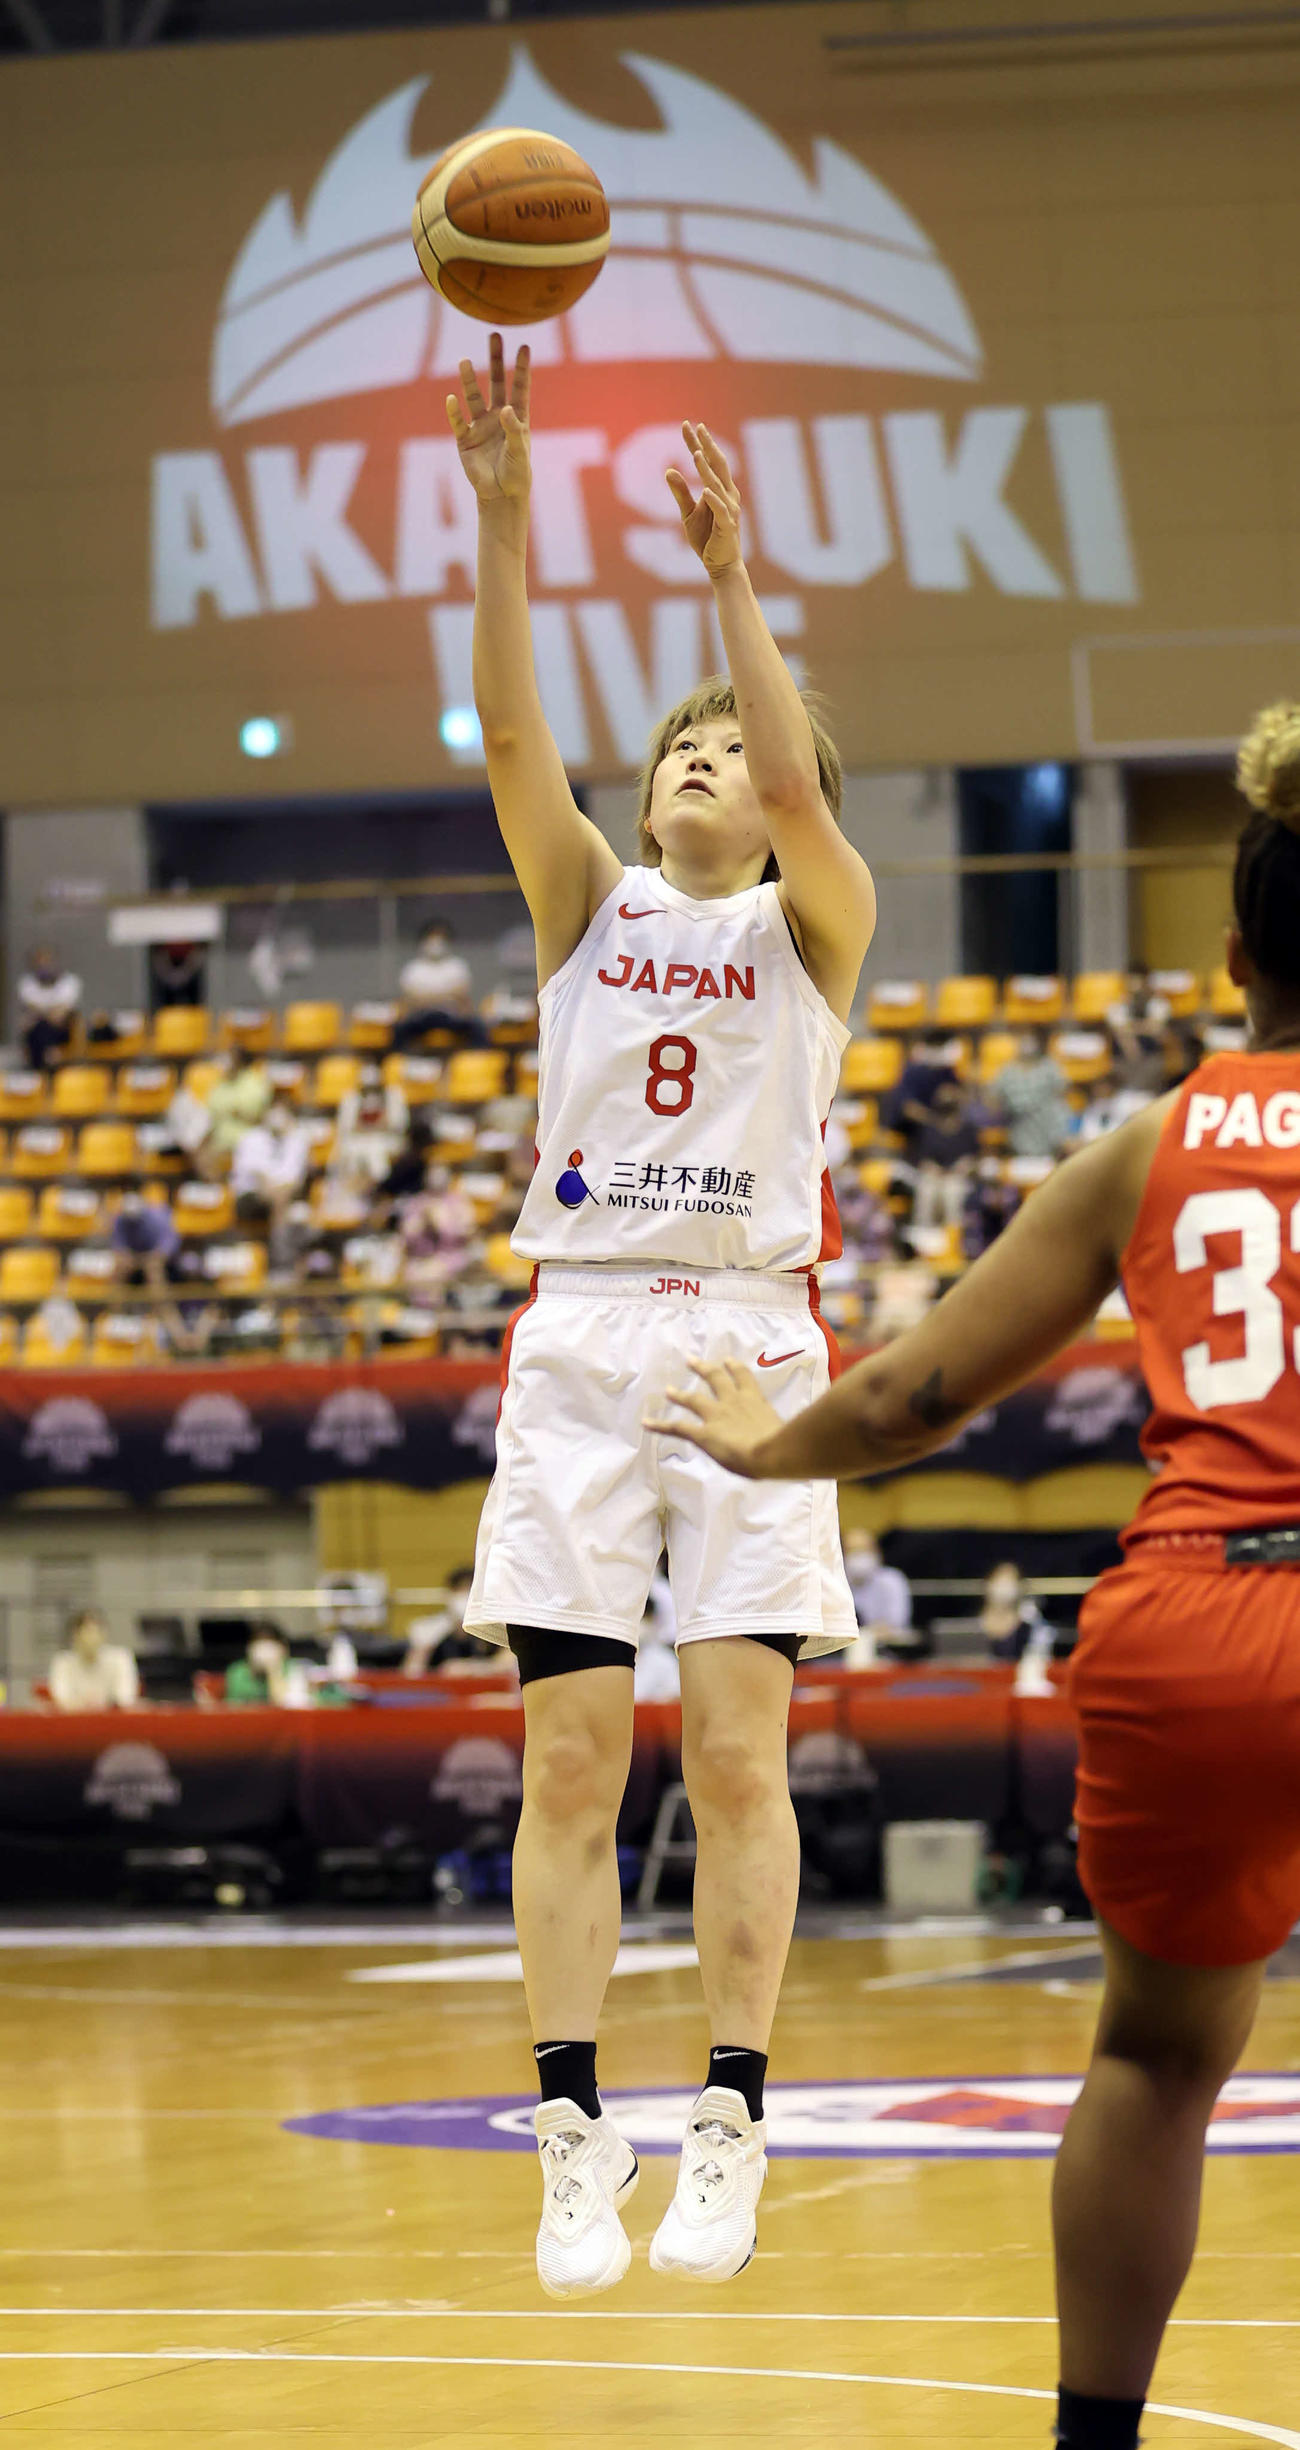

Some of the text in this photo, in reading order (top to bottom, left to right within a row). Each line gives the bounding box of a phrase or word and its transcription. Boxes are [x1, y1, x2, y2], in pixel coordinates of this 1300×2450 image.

[150, 400, 1139, 631] AKATSUKI
[597, 953, 756, 1001] JAPAN
[645, 1034, 698, 1117] 8
[608, 1161, 756, 1199] 三井不動産
[607, 1193, 752, 1218] MITSUI FUDOSAN
[649, 1278, 700, 1297] JPN
[1172, 1187, 1300, 1412] 3
